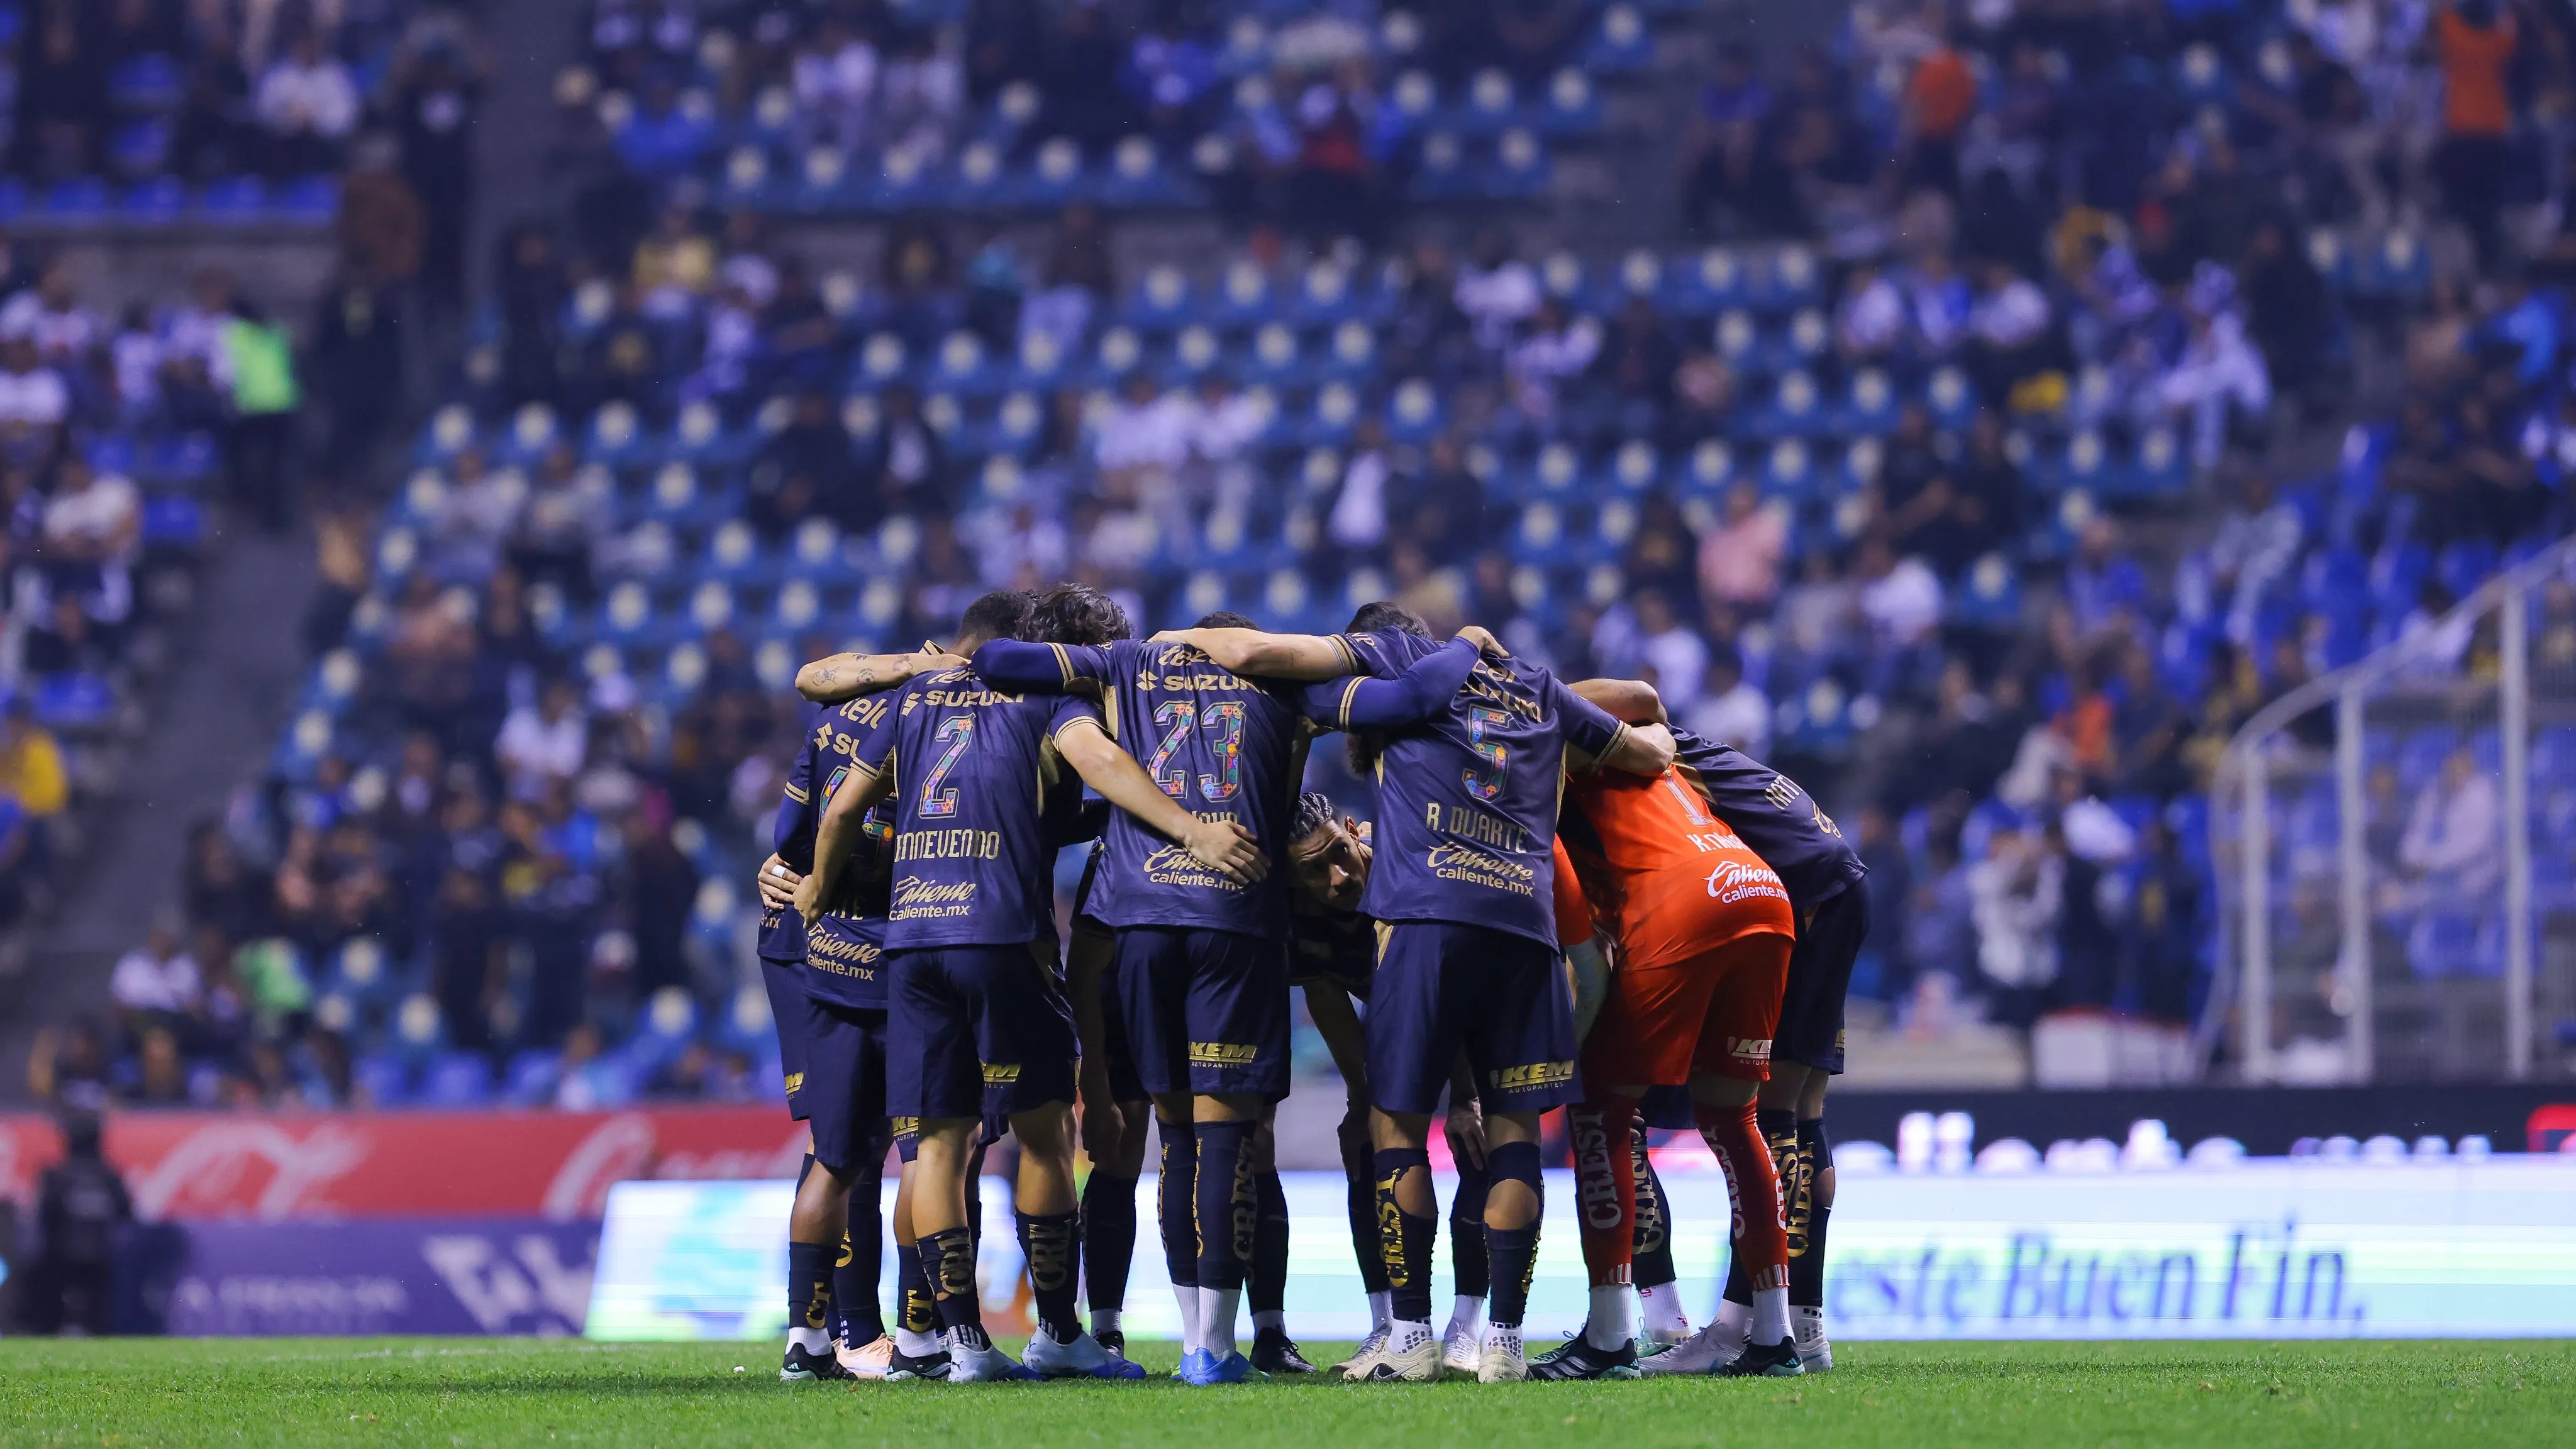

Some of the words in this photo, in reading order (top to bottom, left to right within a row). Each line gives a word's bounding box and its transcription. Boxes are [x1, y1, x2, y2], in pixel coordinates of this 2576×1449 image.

[918, 712, 976, 819] 2
[1148, 699, 1246, 803] 23
[1461, 704, 1514, 804] 5
[1426, 802, 1445, 832] R.
[1449, 806, 1529, 853] DUARTE
[1427, 841, 1534, 880] Caliente
[891, 875, 977, 908] Caliente
[1436, 866, 1533, 897] caliente.mx
[889, 905, 970, 921] caliente.mx
[807, 953, 875, 981] caliente.mx
[1189, 1041, 1258, 1060] KEM
[1501, 1059, 1574, 1083] KEM
[1509, 1082, 1564, 1094] AUTOPARTES
[1570, 1109, 1623, 1230] CREST
[2000, 1228, 2197, 1322] Buen
